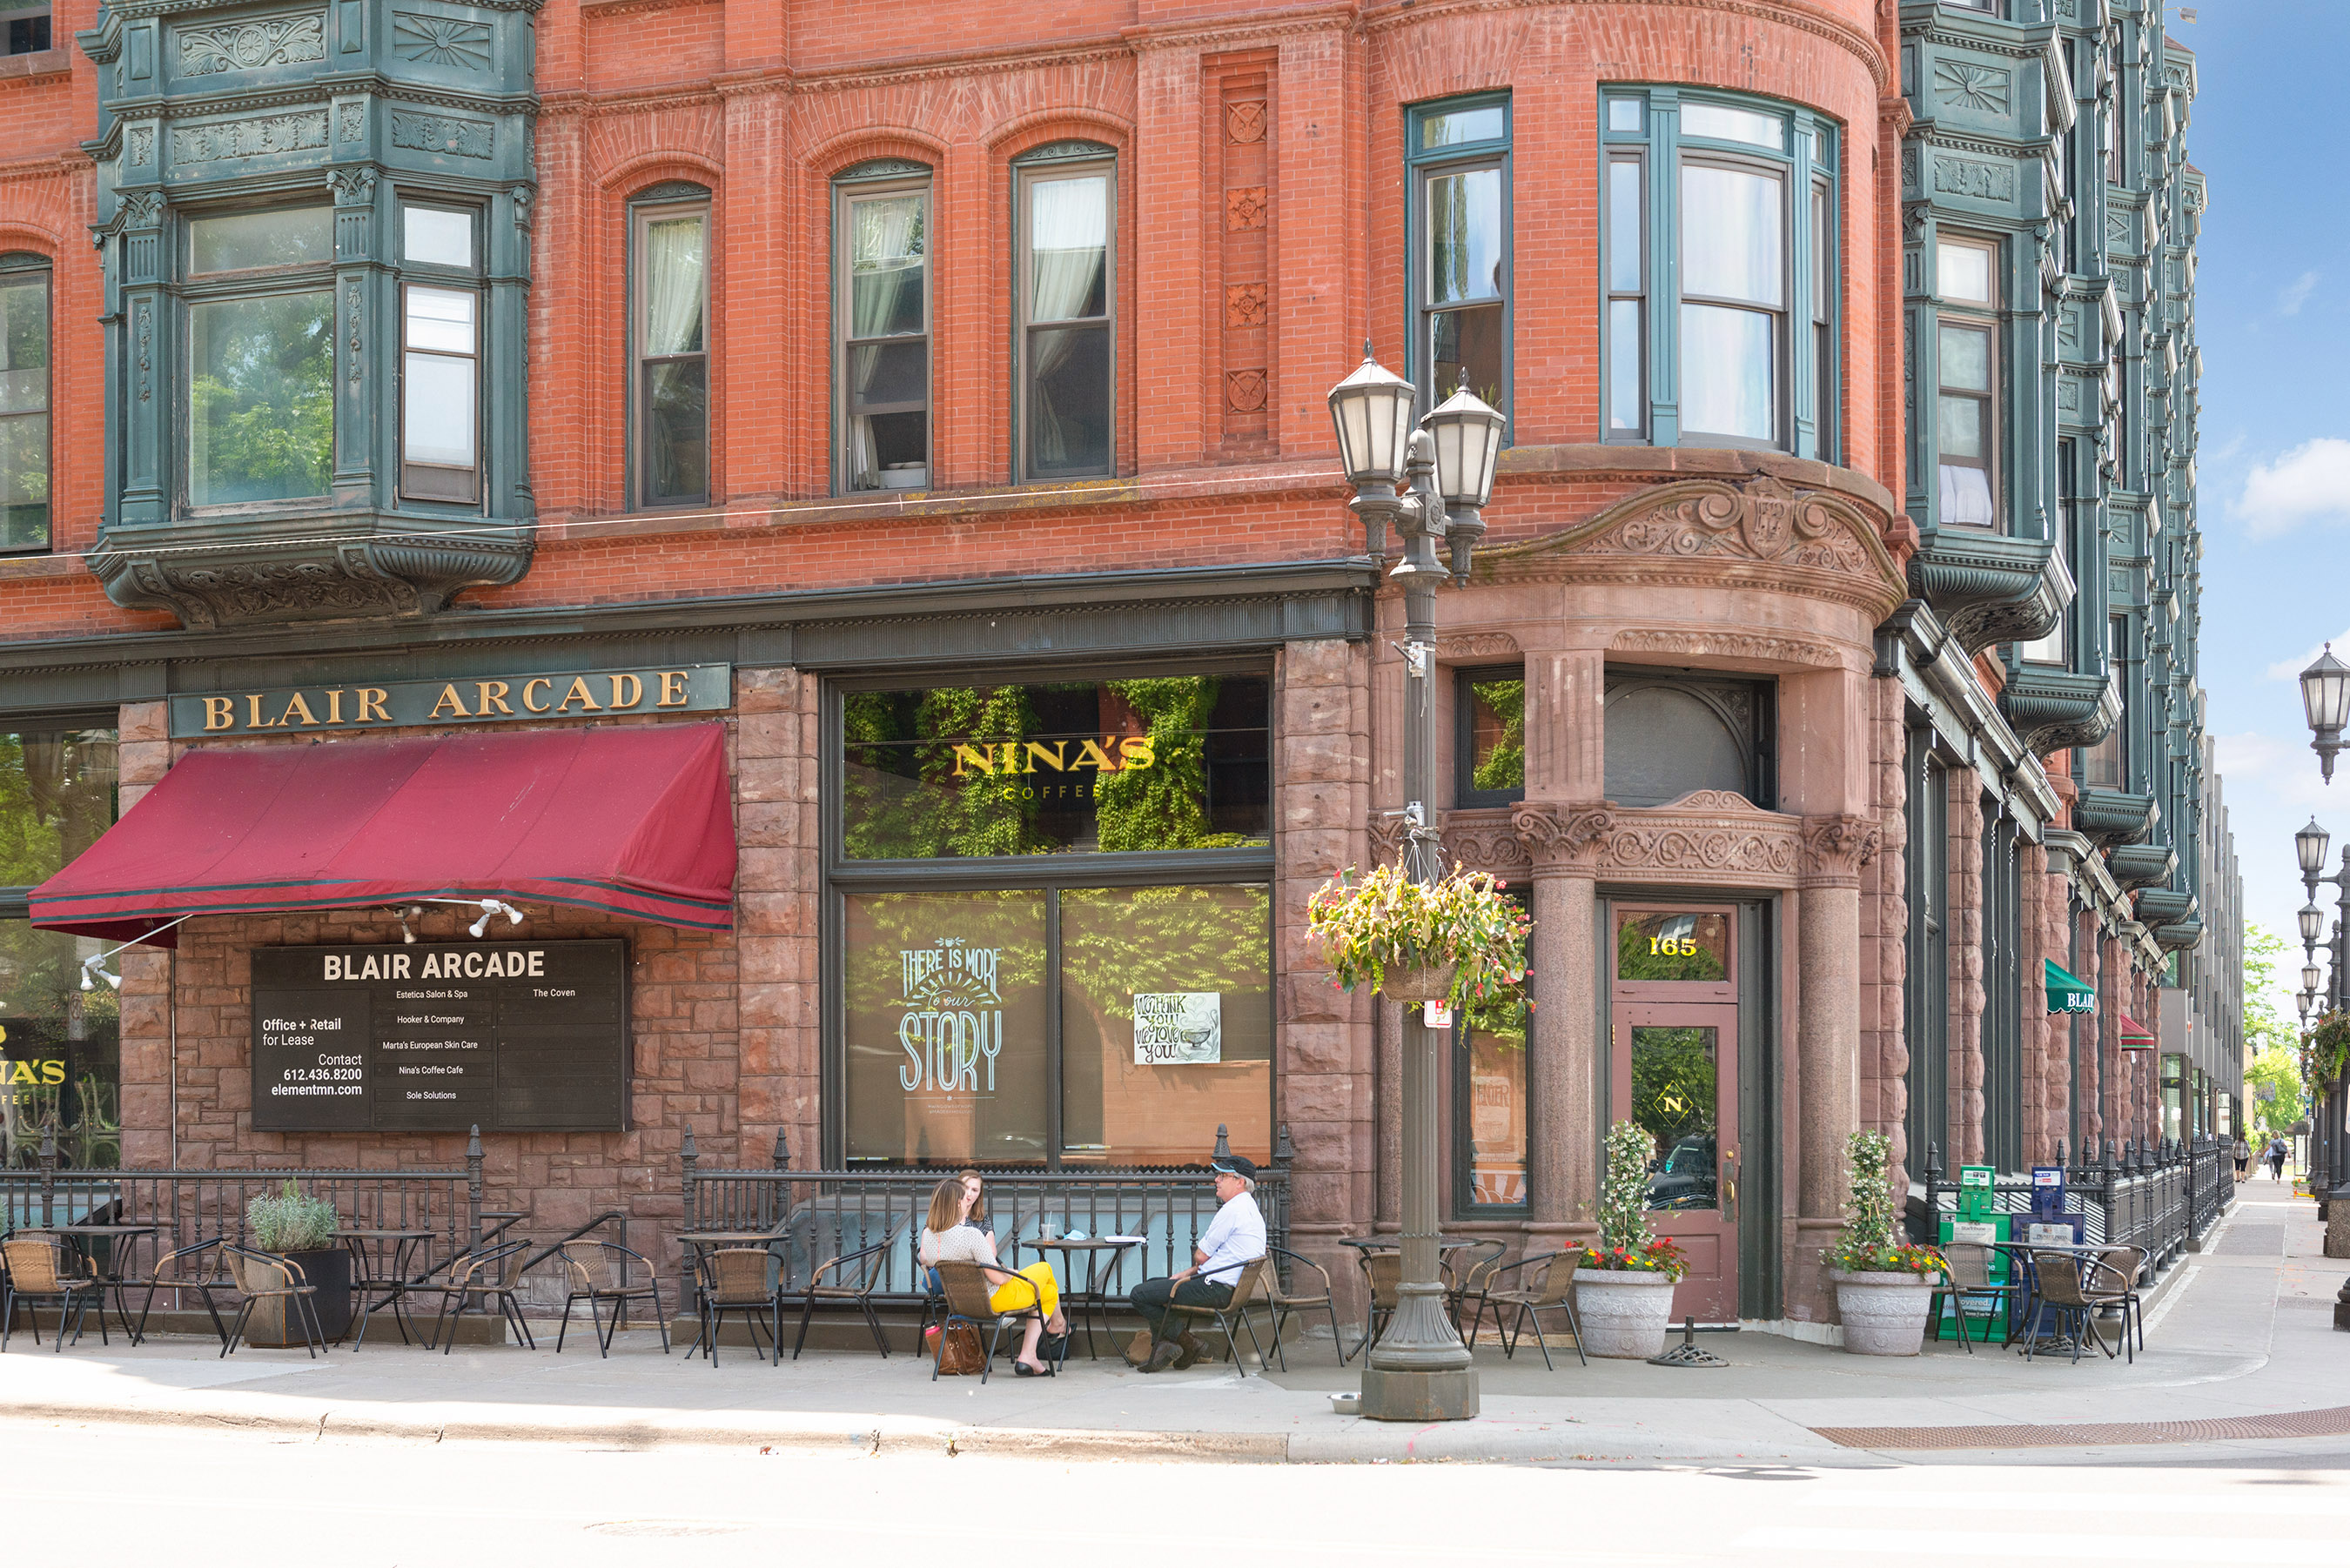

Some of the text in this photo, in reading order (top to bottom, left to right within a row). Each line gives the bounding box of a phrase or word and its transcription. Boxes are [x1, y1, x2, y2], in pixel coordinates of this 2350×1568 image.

[201, 671, 689, 731] BLAIR ARCADE
[951, 736, 1156, 776] NINA'S
[1003, 784, 1101, 801] COFFEE
[1649, 936, 1697, 956] 165
[324, 951, 545, 981] BLAIR ARCADE
[900, 948, 1002, 1002] THERE IS MORE
[396, 990, 468, 1000] Estetica Salon & Spa
[533, 988, 576, 997] The Coven
[943, 995, 975, 1008] our
[262, 1017, 341, 1032] Office + Retail
[397, 1015, 465, 1026] Hooker & Company
[262, 1033, 314, 1047] for Lease
[382, 1040, 479, 1050] Marta's European Skin Care
[899, 1010, 1002, 1092] STORY
[318, 1052, 363, 1066] Contact
[0, 1059, 65, 1085] A'S
[283, 1068, 363, 1082] 612.436.8200
[399, 1065, 464, 1075] Nina's Coffee Cafe
[271, 1082, 363, 1096] elementmn.com
[406, 1090, 457, 1100] Sole Solutions
[1663, 1097, 1683, 1112] N
[1957, 1297, 1991, 1307] overed.
